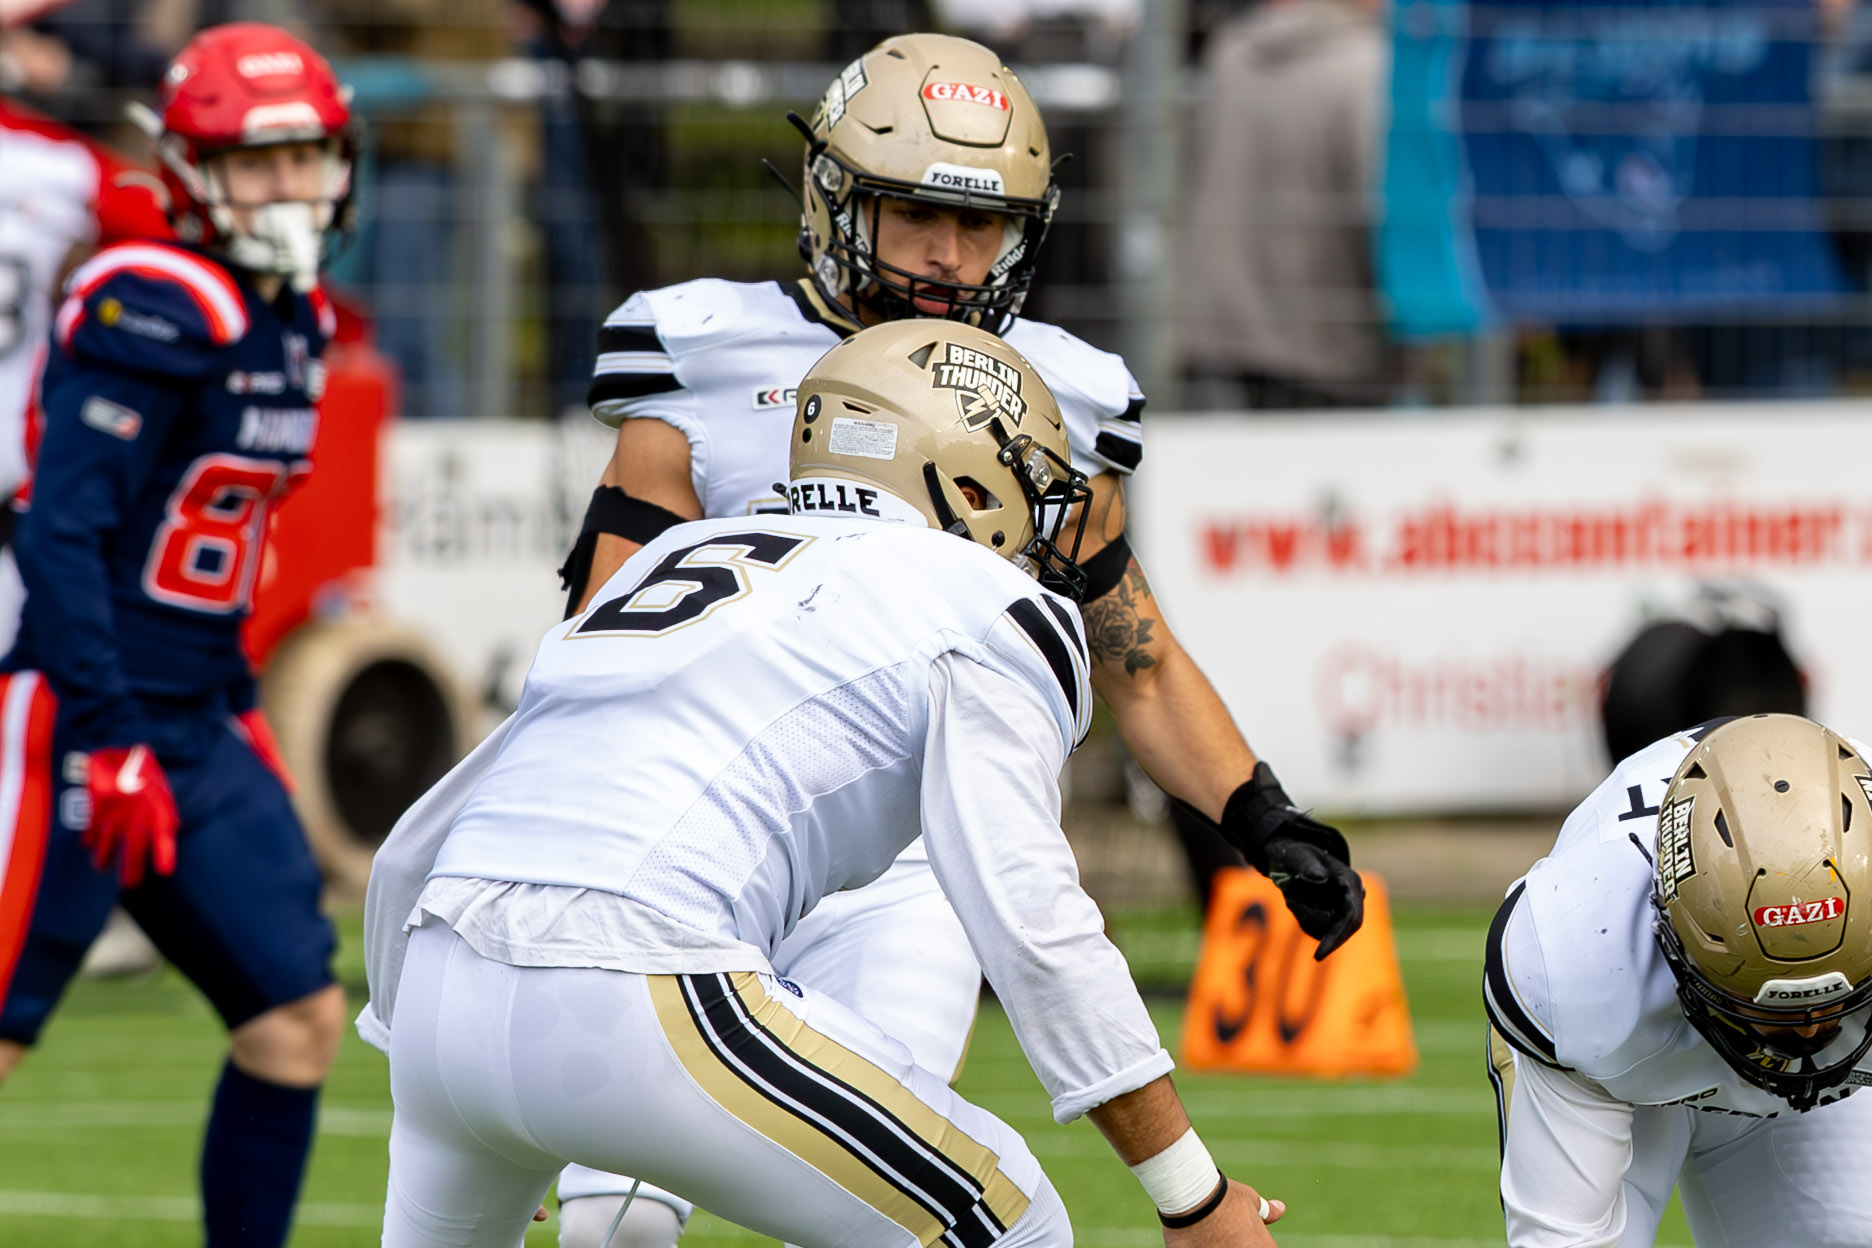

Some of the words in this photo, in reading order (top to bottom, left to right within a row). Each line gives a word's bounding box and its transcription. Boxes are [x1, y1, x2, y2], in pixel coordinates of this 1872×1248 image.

[931, 171, 1000, 192] FORELLE
[940, 365, 1022, 422] THUNDER
[950, 345, 1019, 393] BERLIN
[807, 402, 815, 416] 6
[564, 529, 818, 640] 6
[1661, 804, 1676, 898] THUNDER
[1673, 801, 1693, 879] BERLIN
[1212, 902, 1338, 1044] 30
[1769, 982, 1842, 1000] FORELLE
